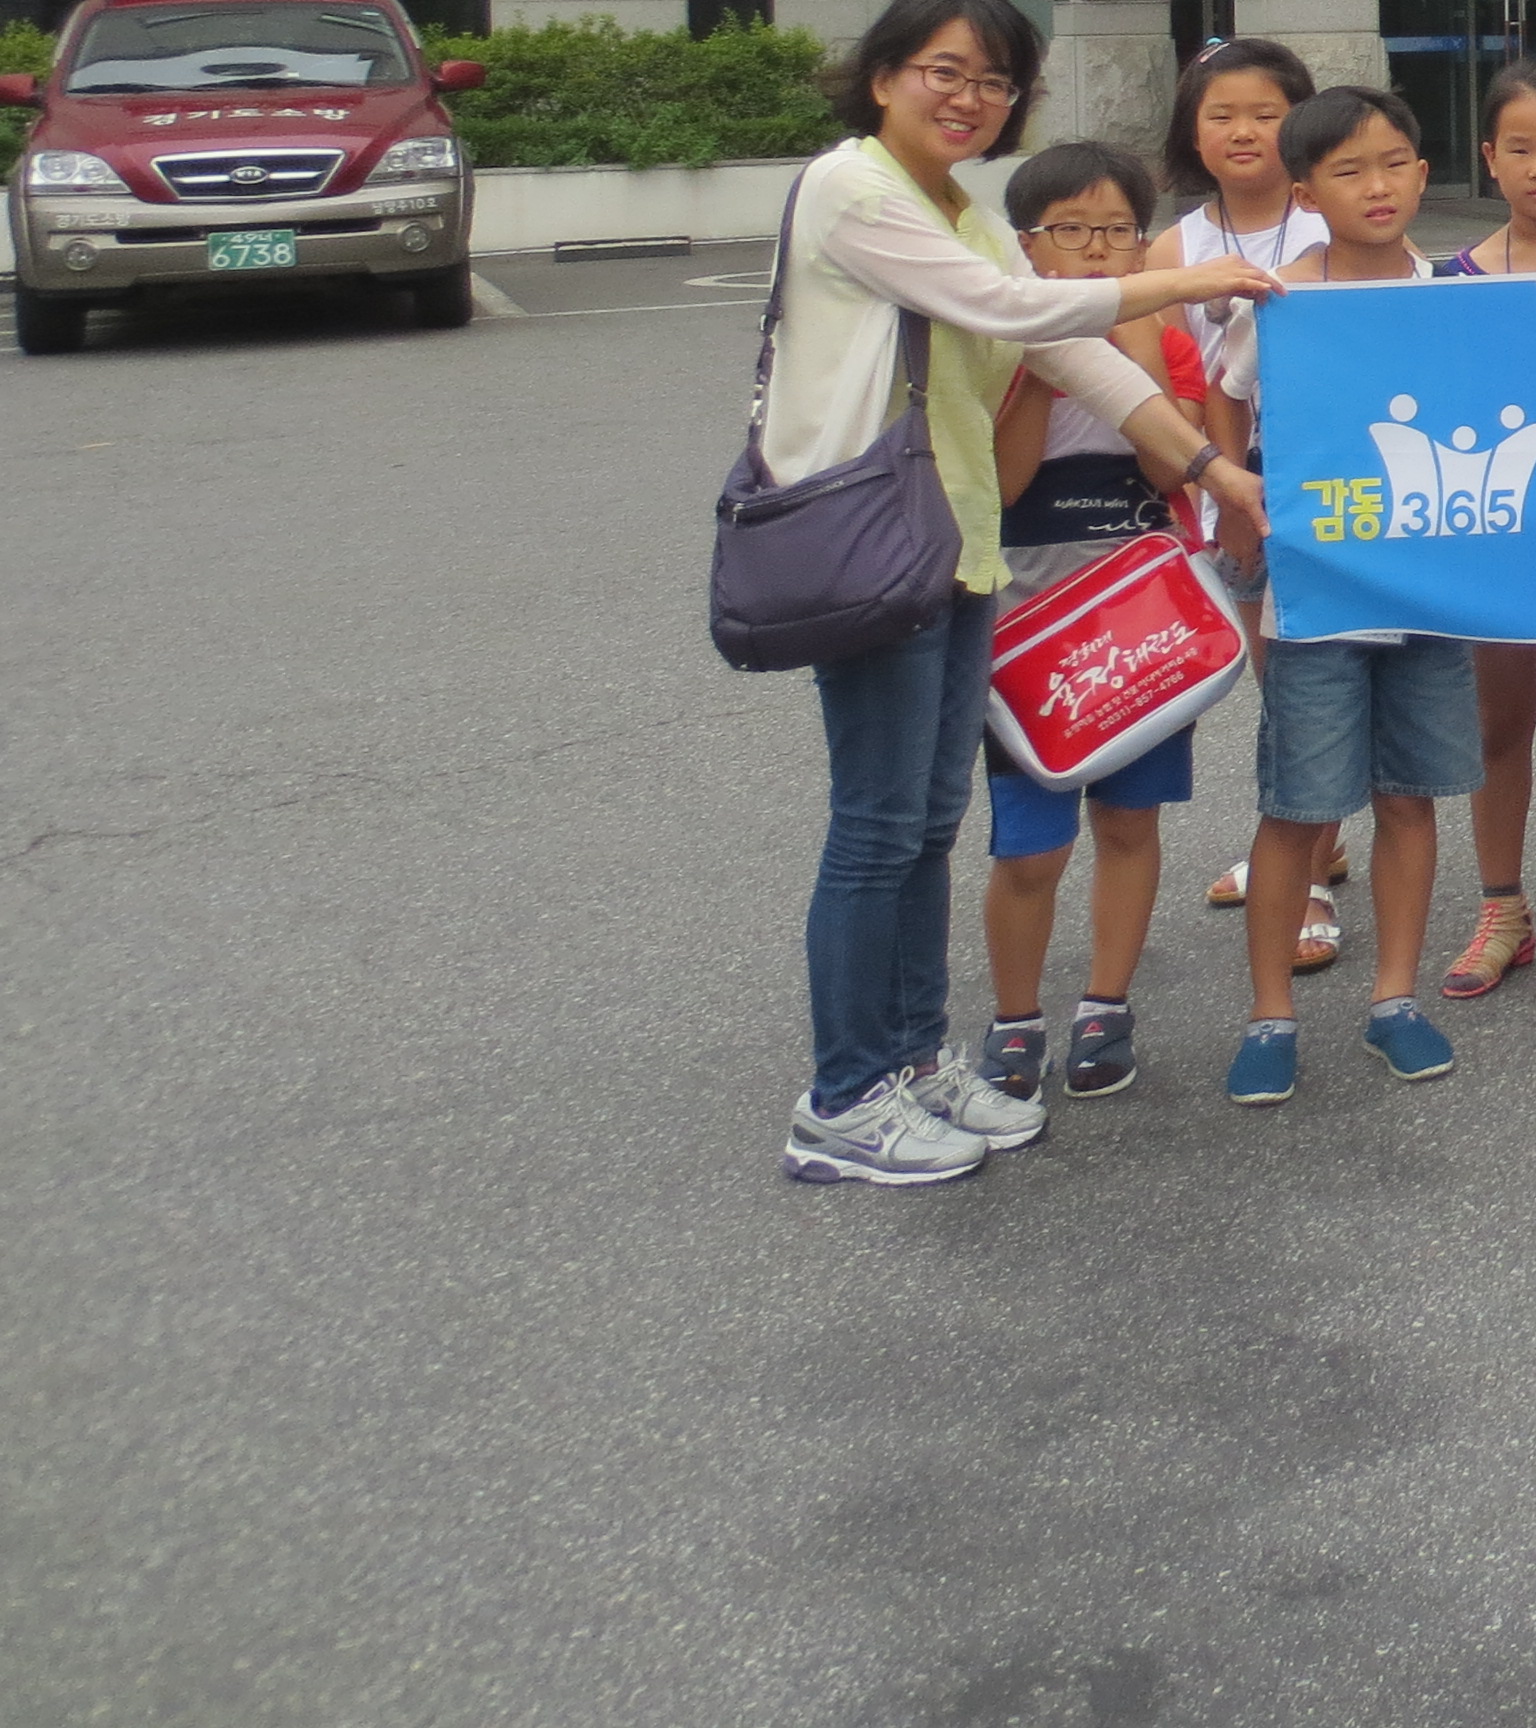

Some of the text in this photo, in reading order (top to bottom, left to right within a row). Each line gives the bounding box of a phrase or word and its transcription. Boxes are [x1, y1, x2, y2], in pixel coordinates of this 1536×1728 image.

[142, 107, 351, 127] 경기도소방
[212, 243, 293, 268] 6738
[1302, 477, 1518, 542] 감동 365
